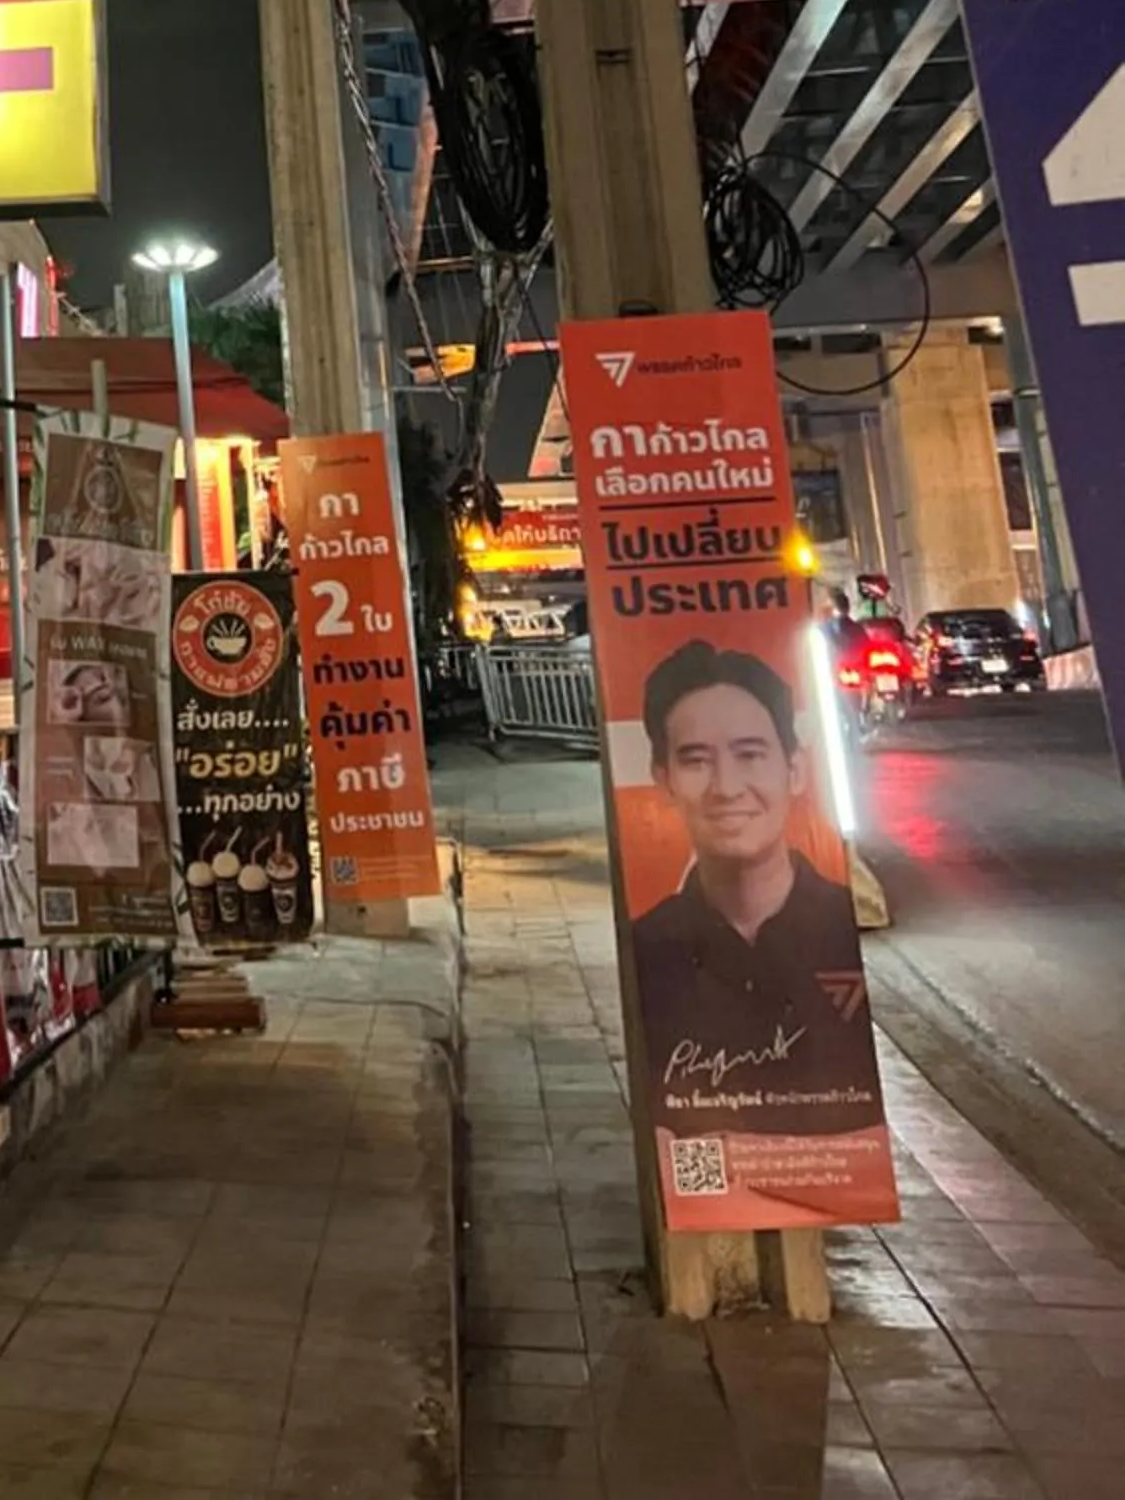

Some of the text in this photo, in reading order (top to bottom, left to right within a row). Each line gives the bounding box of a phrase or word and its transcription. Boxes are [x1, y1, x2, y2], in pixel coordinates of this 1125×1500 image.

[595, 456, 774, 498] เลือกคนใหม่
[319, 492, 360, 518] กา
[300, 530, 389, 560] ก้าวไกล
[601, 507, 781, 562] ไปเปลี่ยน
[310, 580, 393, 637] 2 ใบ
[612, 575, 789, 617] ประเทศ
[313, 653, 405, 684] ทำงาน
[320, 698, 411, 751] คุ้มค่า
[337, 752, 405, 793] ภาษี
[330, 810, 424, 834] ประชาชน
